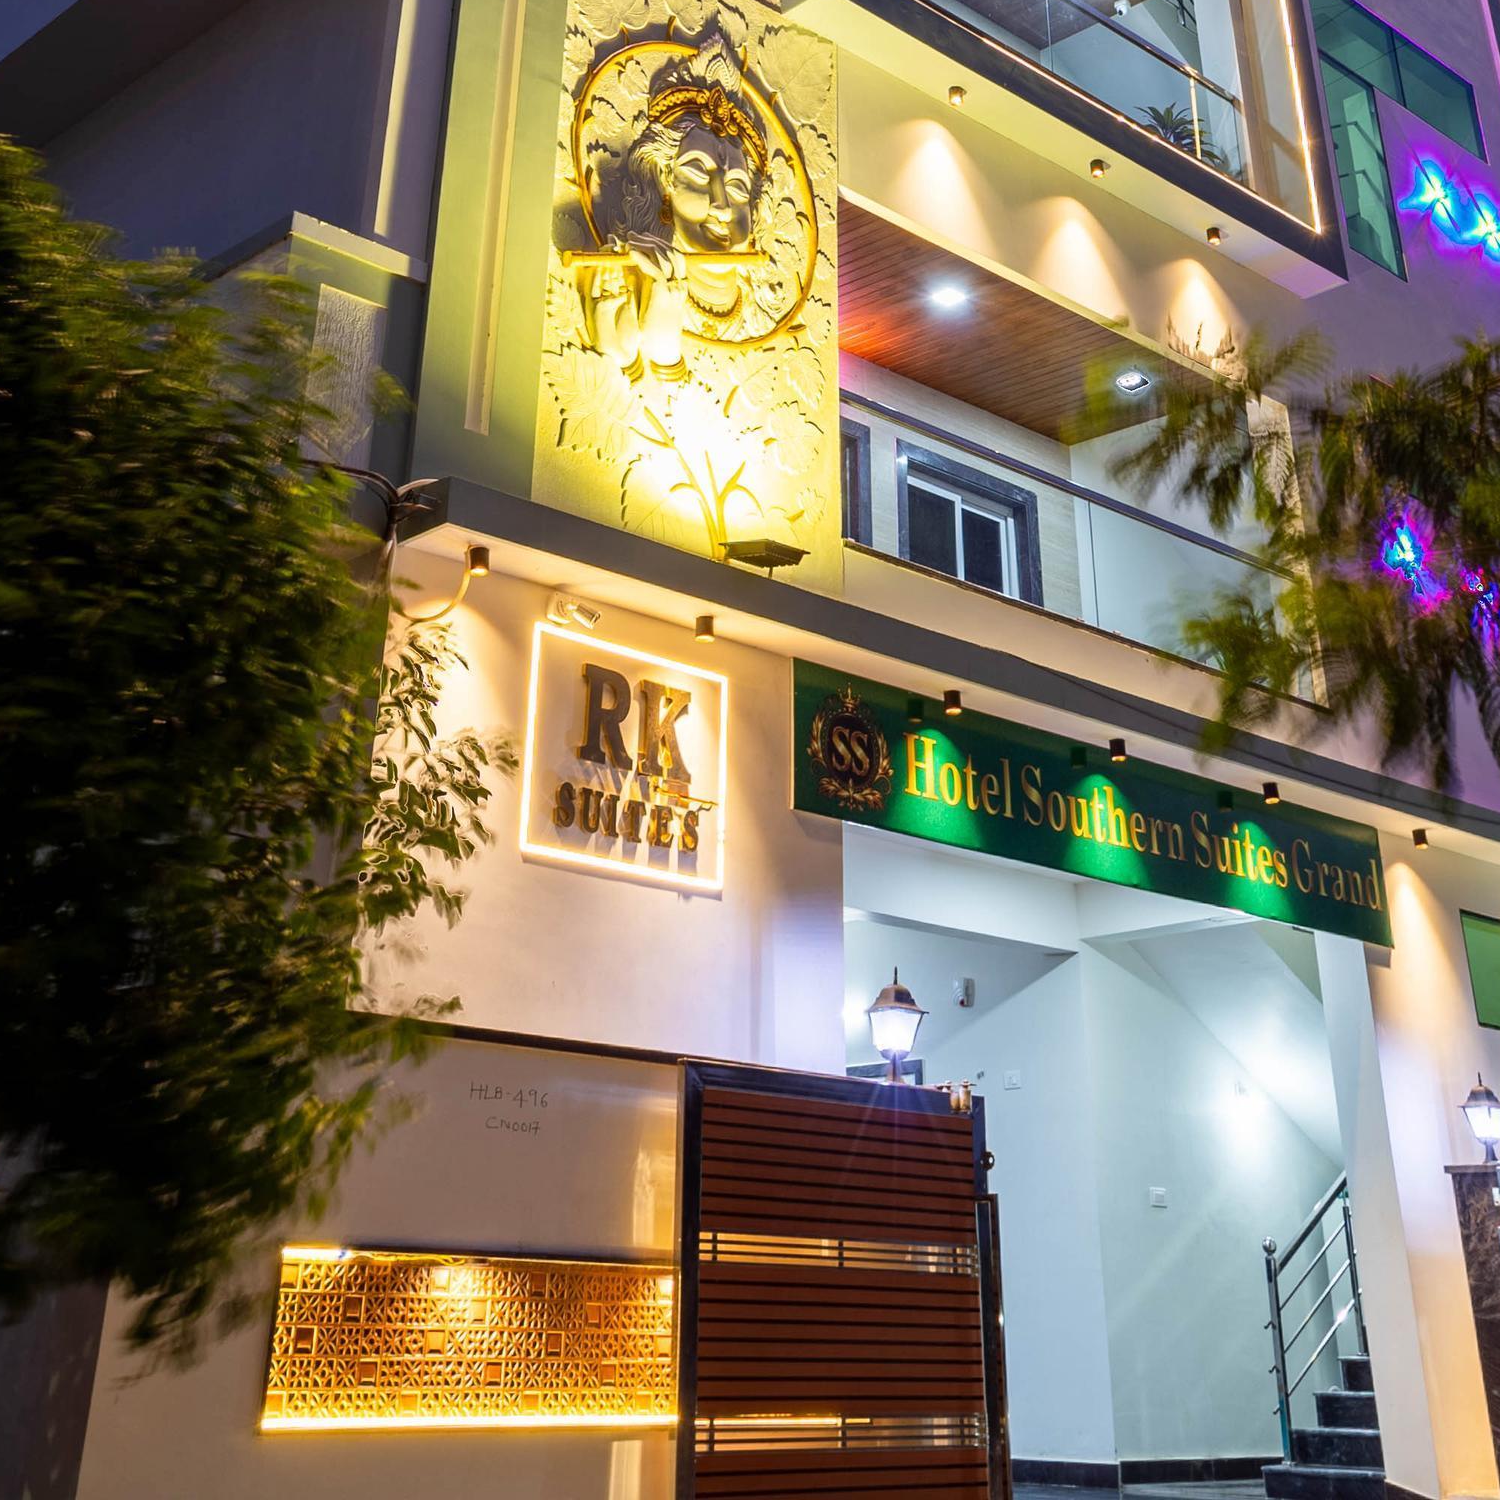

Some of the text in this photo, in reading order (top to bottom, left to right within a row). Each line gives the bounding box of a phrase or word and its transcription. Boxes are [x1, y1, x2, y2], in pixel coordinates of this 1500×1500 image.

[576, 663, 691, 785] RK
[831, 725, 870, 777] SS
[553, 782, 700, 853] SUITES
[902, 731, 1383, 912] Hotel Southern Suites Grand
